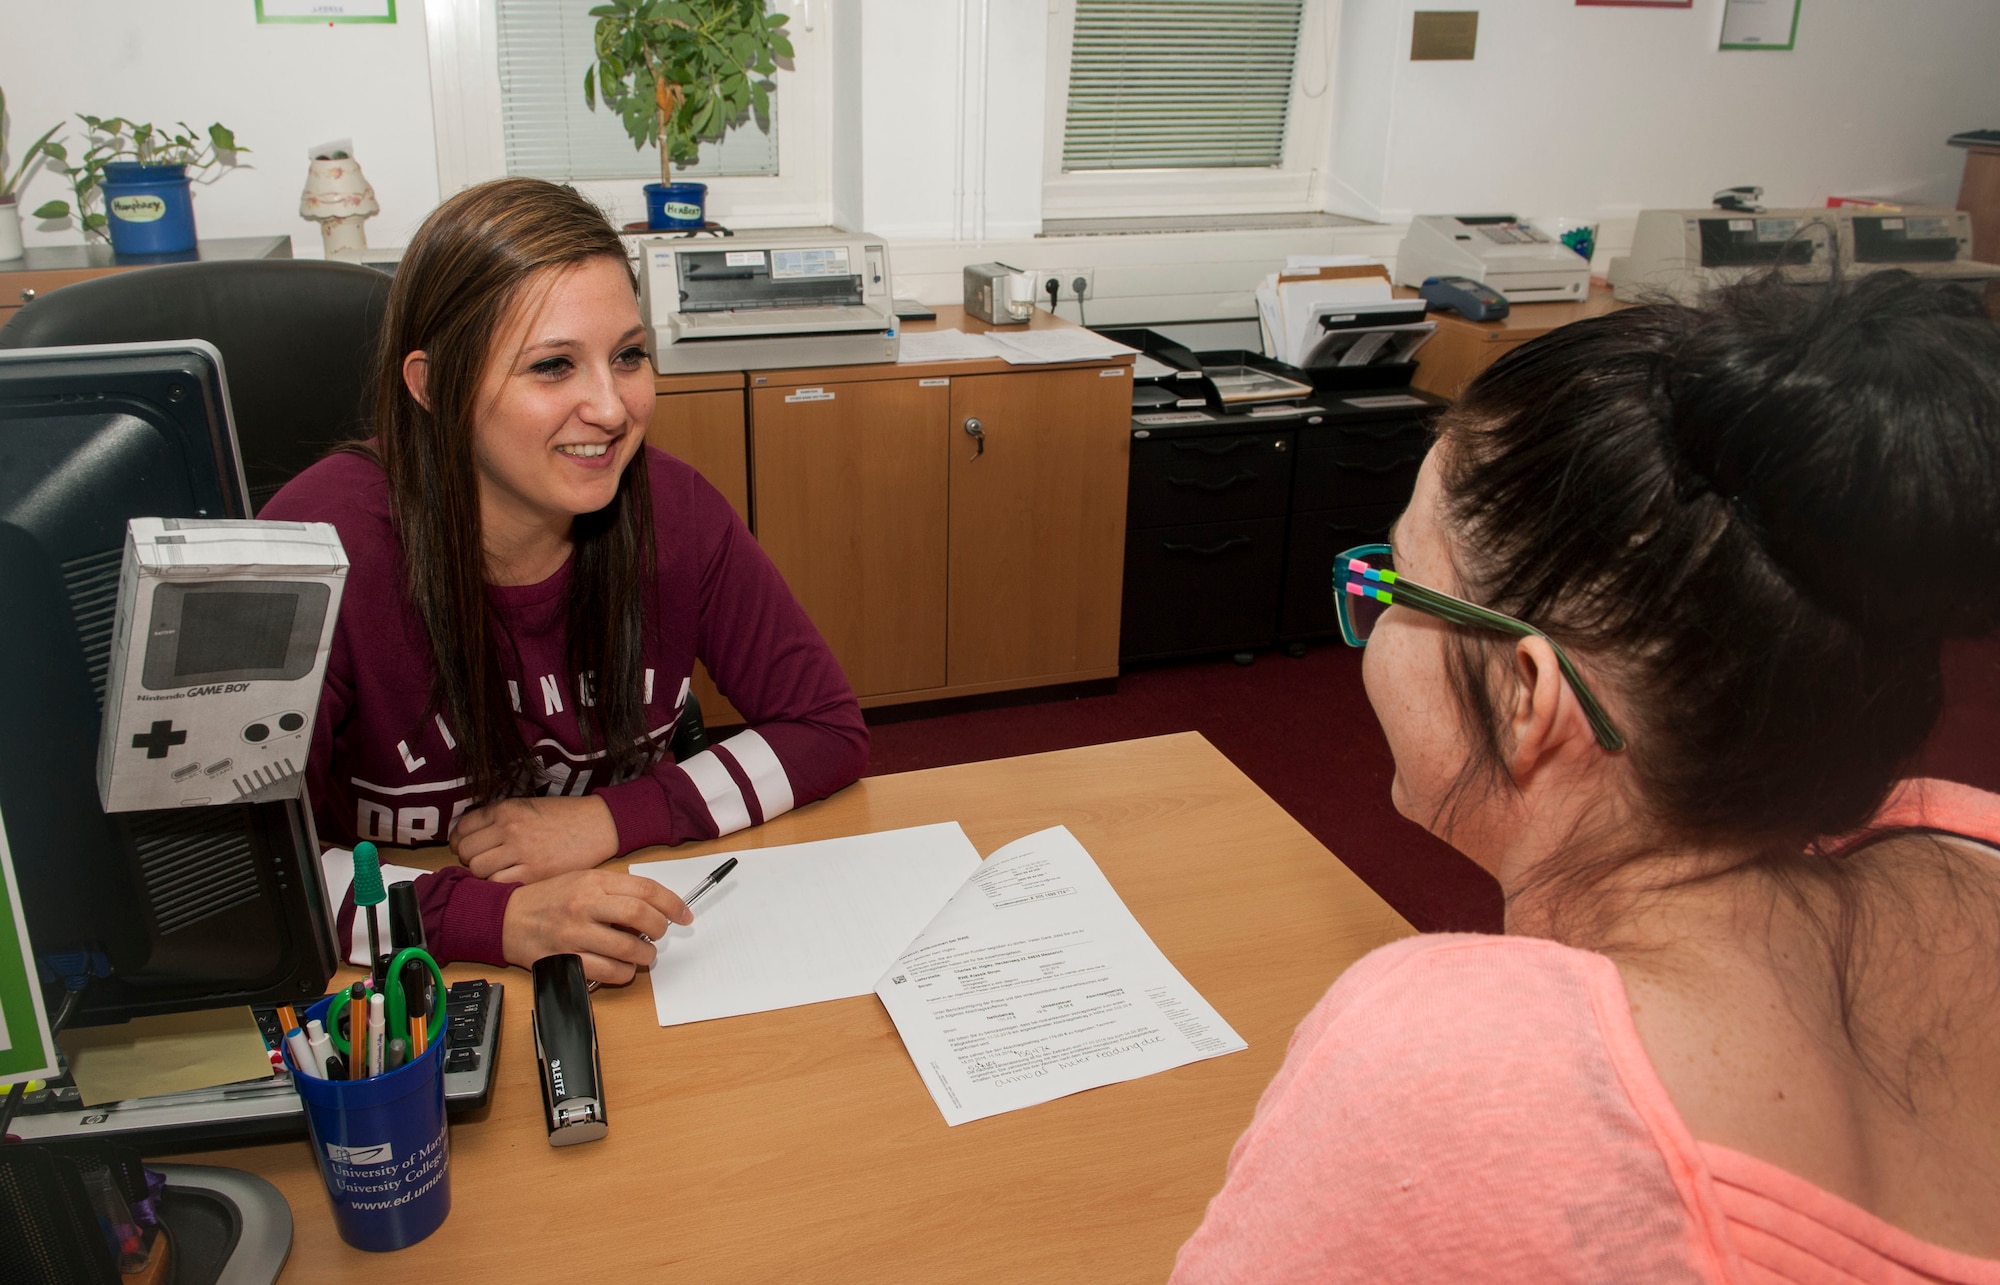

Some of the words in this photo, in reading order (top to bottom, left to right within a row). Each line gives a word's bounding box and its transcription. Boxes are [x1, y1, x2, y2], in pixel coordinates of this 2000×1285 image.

[114, 199, 160, 213] Humphrey
[136, 692, 186, 702] Nintendo
[187, 685, 223, 698] GAME
[224, 683, 250, 694] BOY
[209, 766, 234, 779] START
[552, 1066, 566, 1097] LEITZ
[332, 1163, 398, 1179] University
[402, 1153, 417, 1170] of
[336, 1178, 402, 1194] University
[405, 1151, 443, 1183] College
